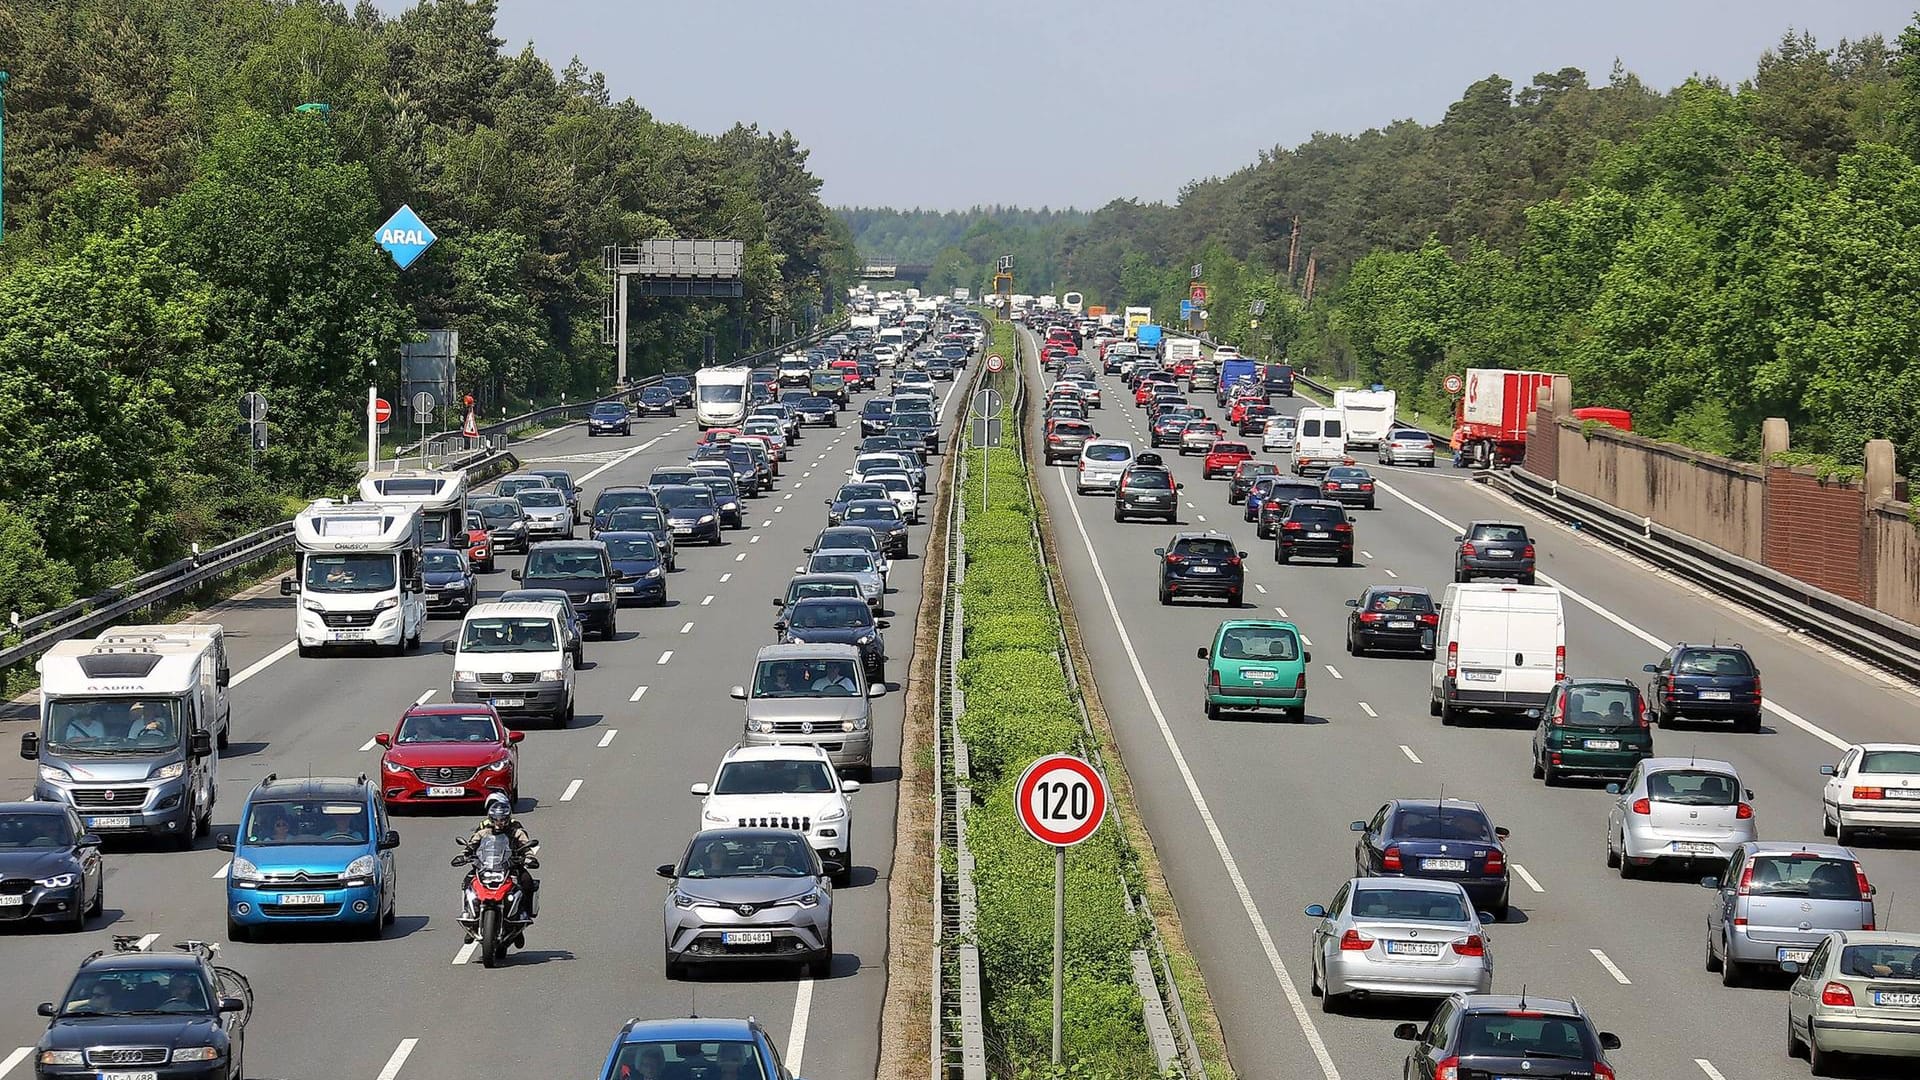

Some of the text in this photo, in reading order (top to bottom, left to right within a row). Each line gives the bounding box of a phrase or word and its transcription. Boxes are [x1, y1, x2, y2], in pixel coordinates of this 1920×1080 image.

[381, 229, 427, 246] ARAL
[1037, 782, 1089, 820] 120
[1785, 951, 1796, 960] HH
[1881, 993, 1892, 1003] SK
[1898, 994, 1910, 1004] AC
